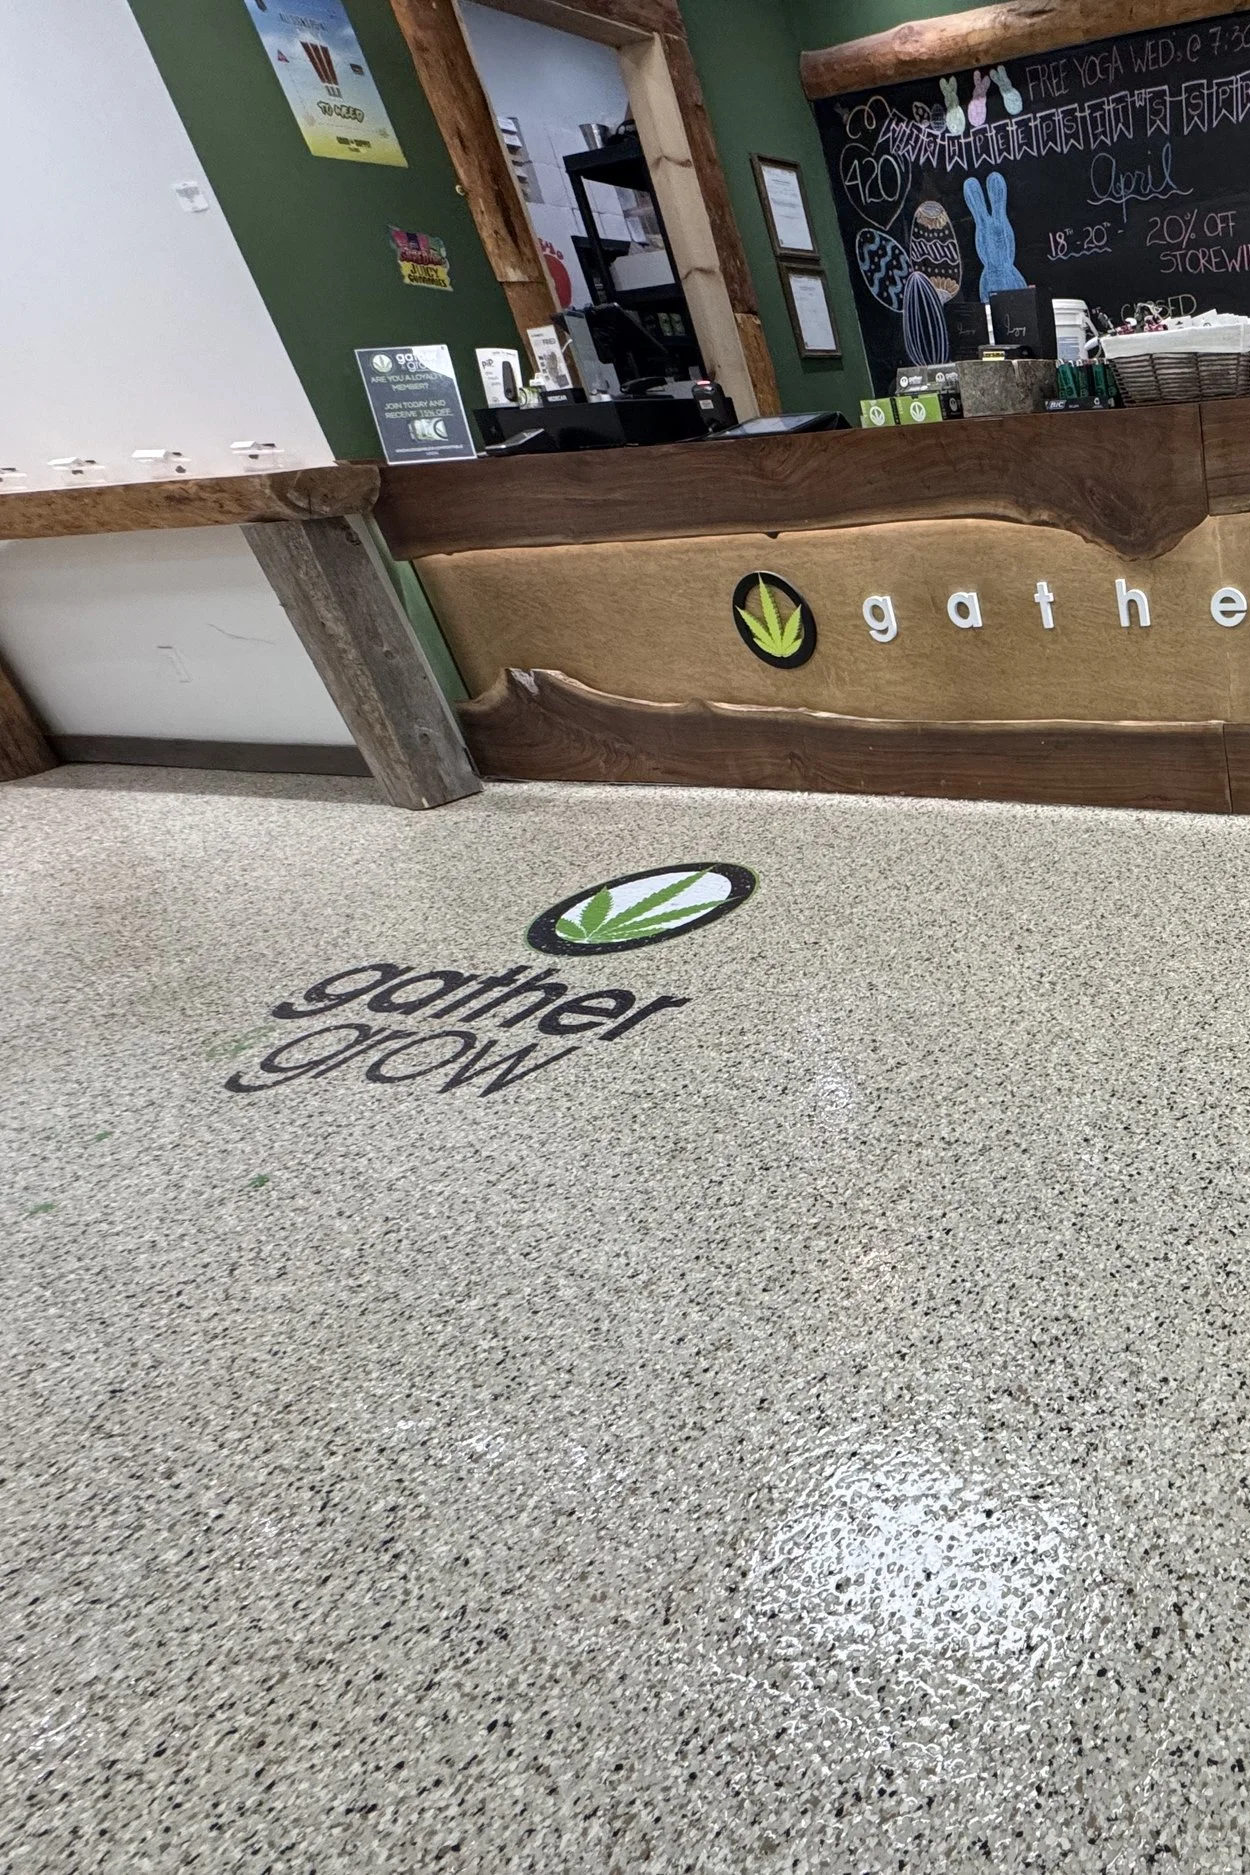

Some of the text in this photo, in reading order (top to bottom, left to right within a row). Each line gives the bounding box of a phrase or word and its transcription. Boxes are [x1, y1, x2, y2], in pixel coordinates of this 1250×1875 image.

[1026, 59, 1069, 101] FREE
[1074, 45, 1124, 89] YOGA
[972, 110, 1080, 162] PEEPS
[845, 155, 900, 205] 420
[1147, 209, 1237, 248] 20% OFF
[272, 962, 693, 1041] gather
[224, 1022, 582, 1097] grow
